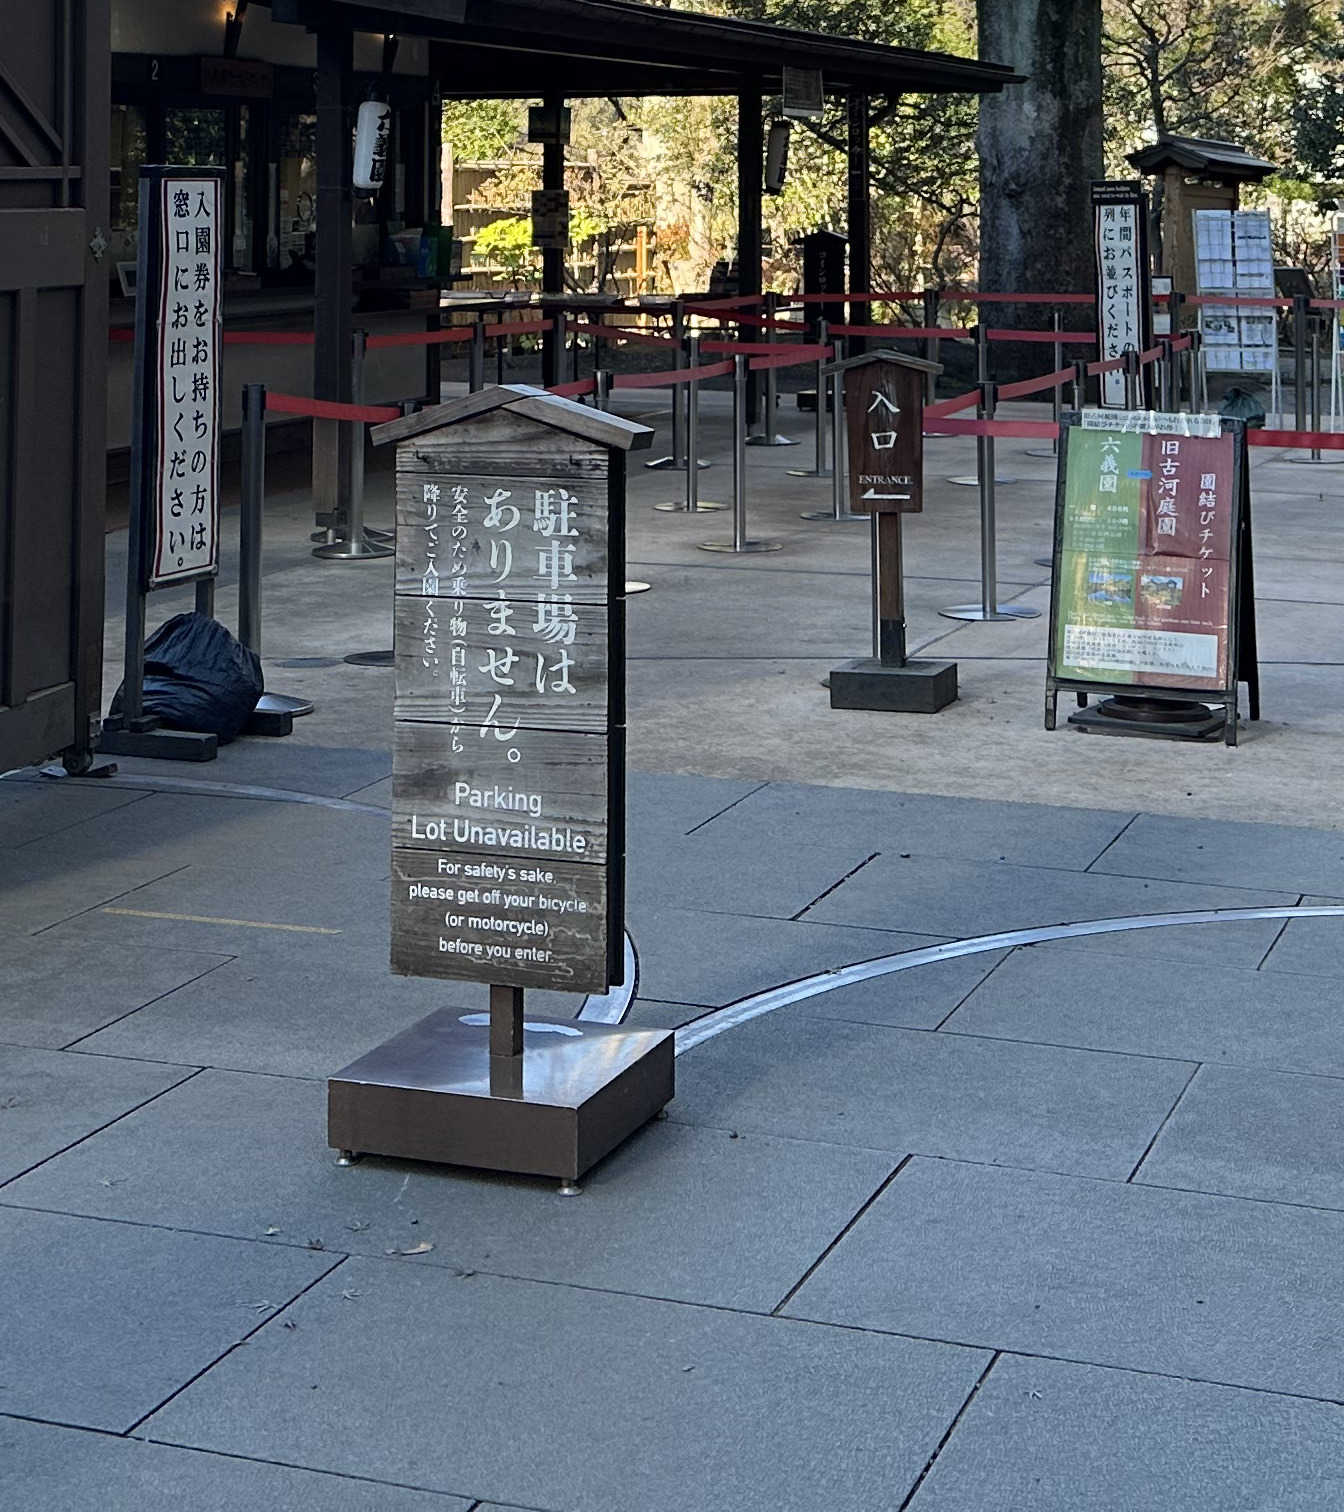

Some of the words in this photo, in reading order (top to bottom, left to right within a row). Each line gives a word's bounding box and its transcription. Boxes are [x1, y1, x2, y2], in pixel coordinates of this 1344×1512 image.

[152, 59, 159, 80] 2
[169, 188, 190, 567] 窓口にお出しください。
[189, 191, 210, 551] 入園券をお持ちの方は
[867, 390, 900, 450] 入口
[858, 475, 912, 485] ENTRANCE
[1098, 436, 1122, 494] 六義園
[1156, 440, 1180, 537] 旧古河庭園
[1198, 473, 1216, 599] 園結びチケット
[422, 483, 440, 677] 降りてご入園ください。
[532, 488, 579, 694] 駐車場は
[478, 488, 521, 763] ありません。
[455, 782, 542, 818] Parking
[411, 815, 447, 841] Lot
[453, 818, 586, 853] Unavailable
[409, 883, 453, 900] please
[458, 889, 479, 905] get
[482, 890, 501, 904] off
[504, 894, 535, 909] your
[539, 894, 587, 914] bicycle
[438, 858, 460, 875] For
[464, 862, 516, 882] safety's
[439, 937, 482, 955] before
[486, 945, 511, 959] you
[514, 946, 554, 963] enter.
[445, 911, 465, 927] (or
[468, 916, 549, 937] motorcycle)
